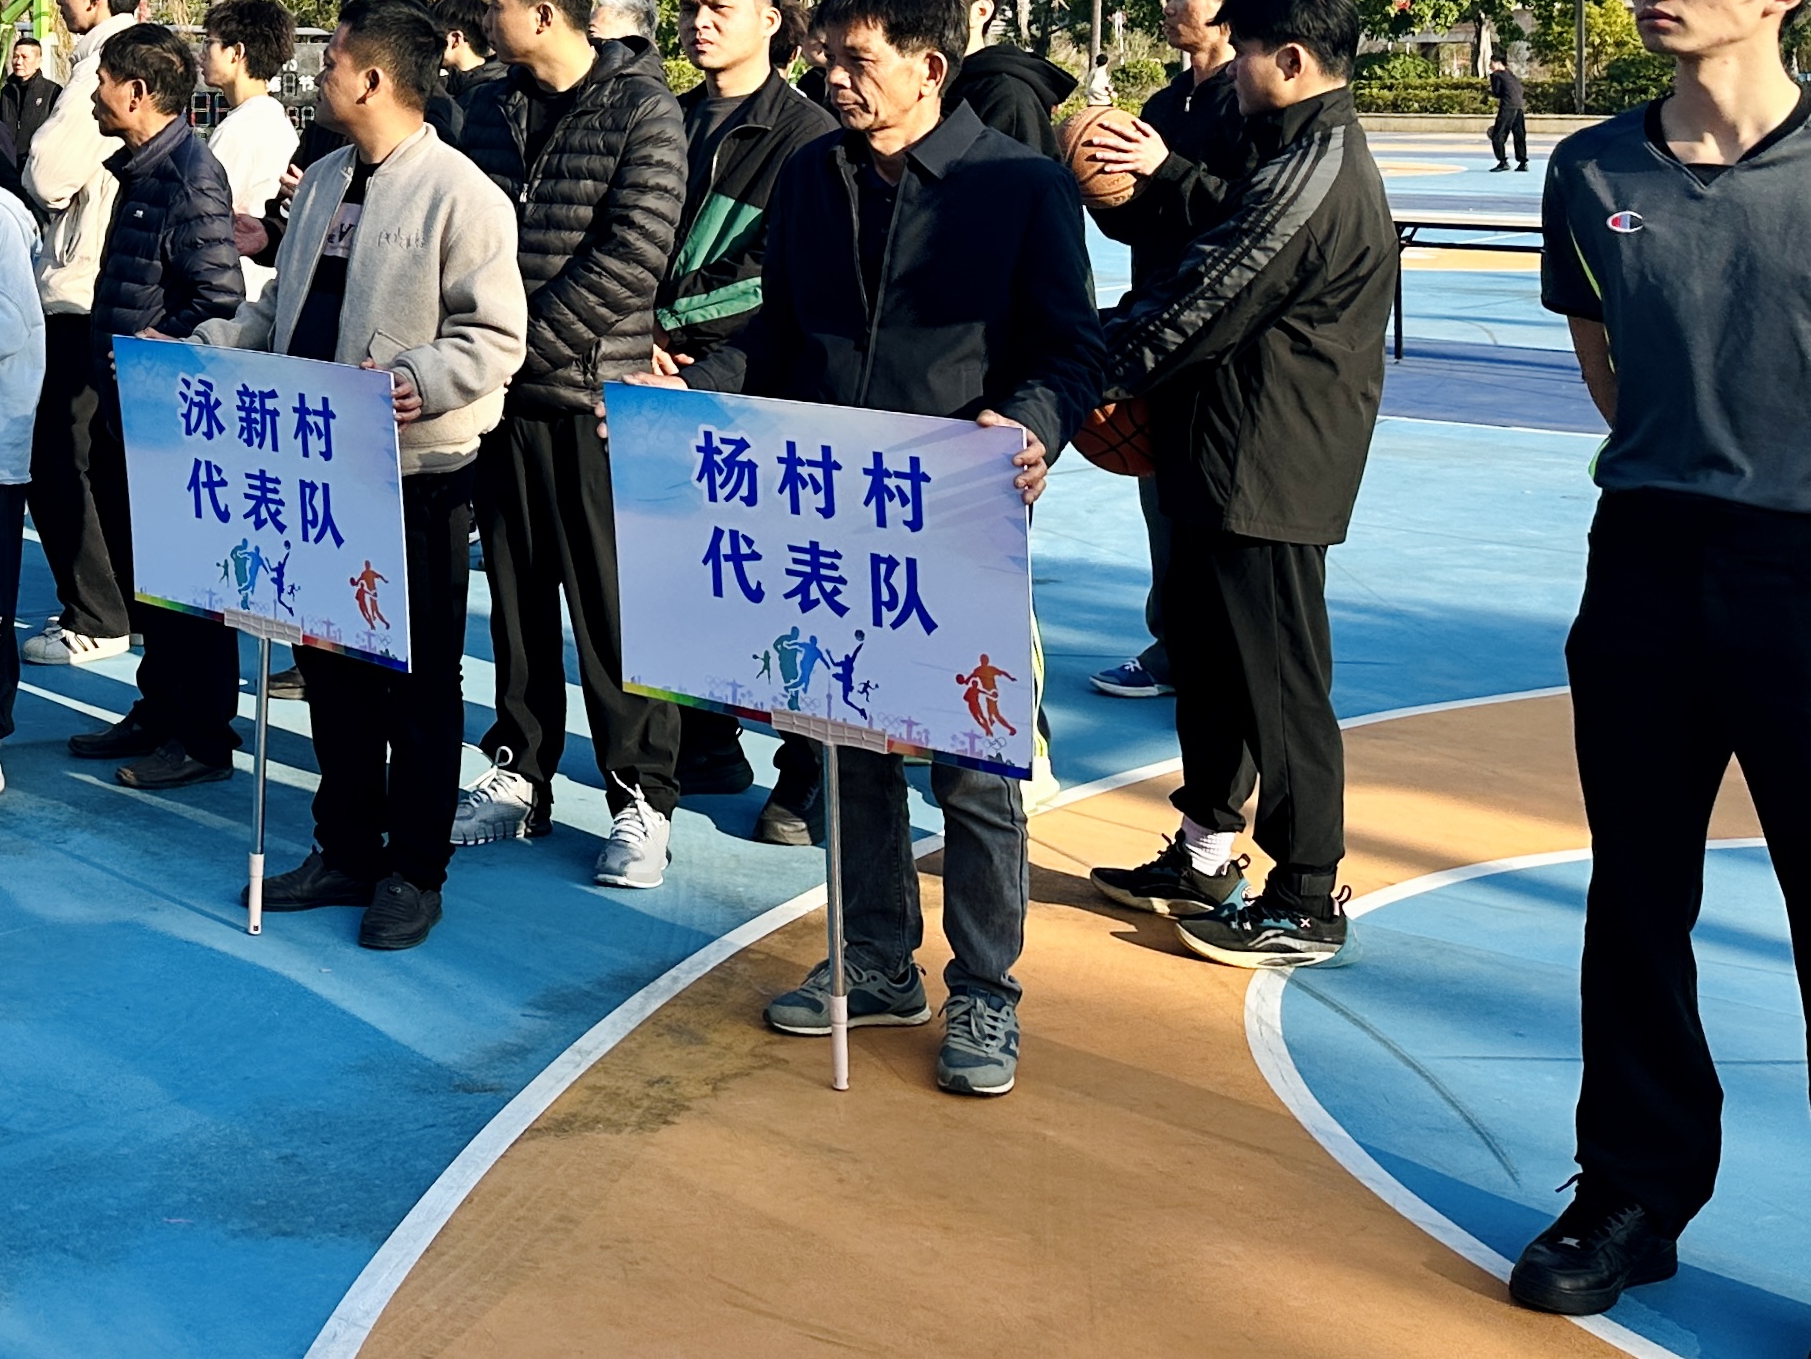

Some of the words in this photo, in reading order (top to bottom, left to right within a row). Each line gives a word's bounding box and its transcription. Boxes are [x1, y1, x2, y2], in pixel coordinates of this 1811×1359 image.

[178, 377, 338, 462] 泳新村
[186, 457, 346, 550] 代表队
[695, 430, 932, 533] 杨村村
[701, 525, 940, 637] 代表队
